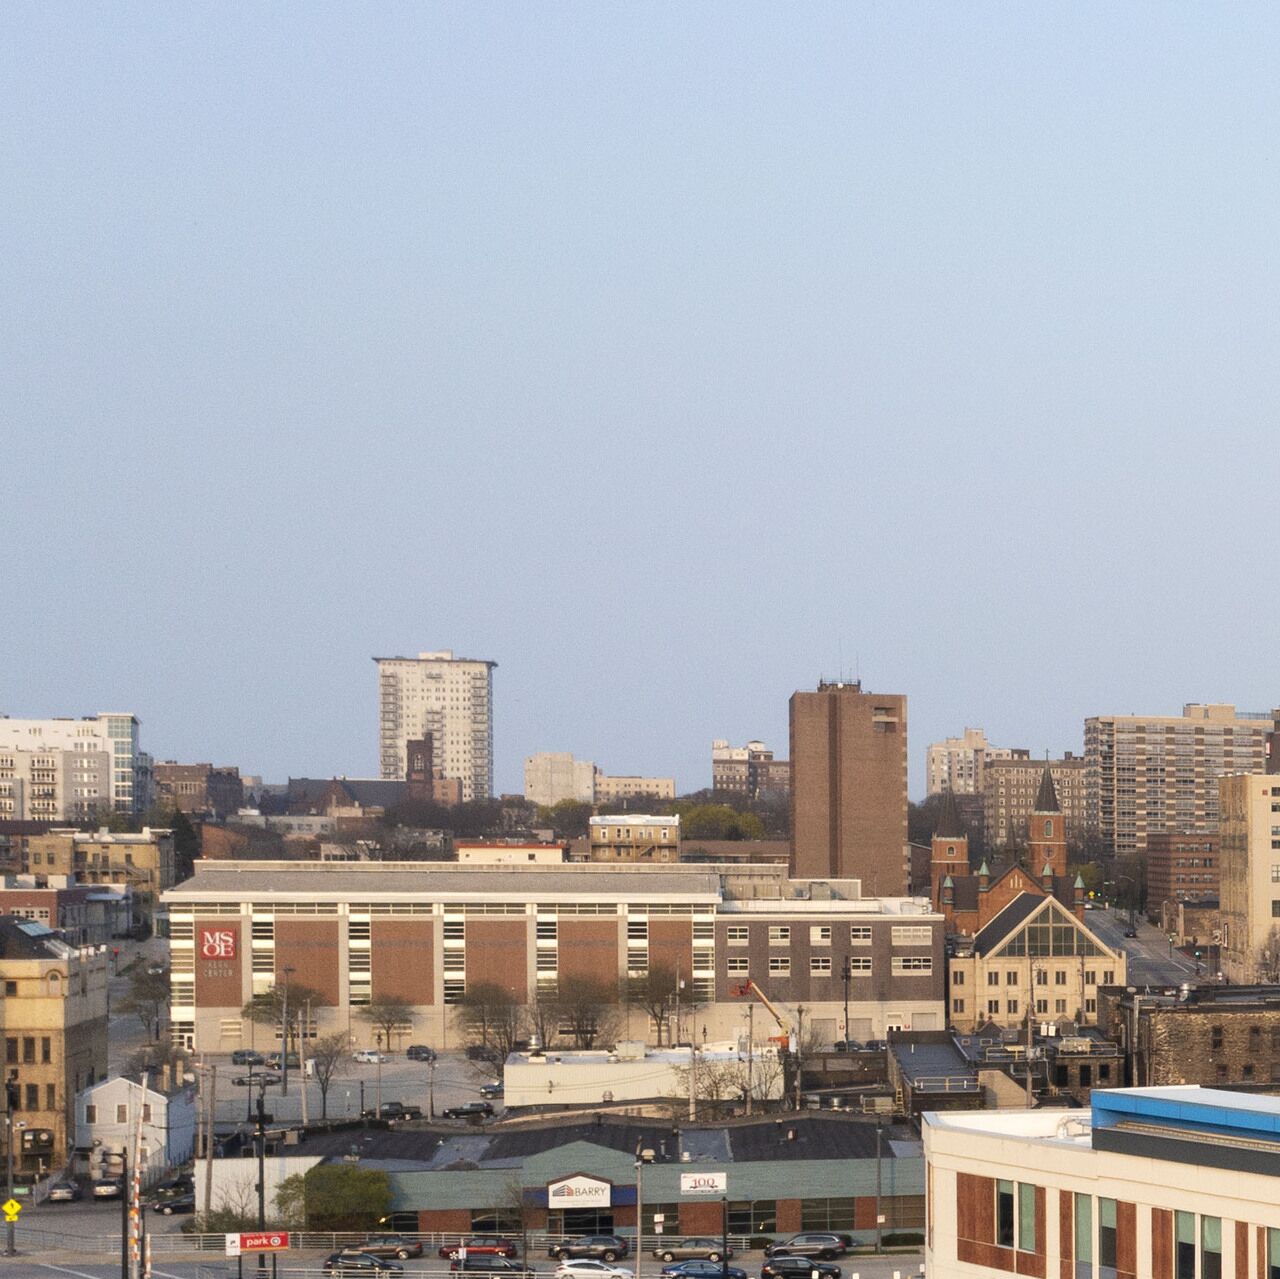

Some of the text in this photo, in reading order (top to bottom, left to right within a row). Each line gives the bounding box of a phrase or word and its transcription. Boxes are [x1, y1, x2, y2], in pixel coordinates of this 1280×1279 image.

[203, 931, 234, 945] MS
[203, 943, 234, 957] OE
[574, 1186, 607, 1197] BARRY
[246, 1237, 269, 1248] park
